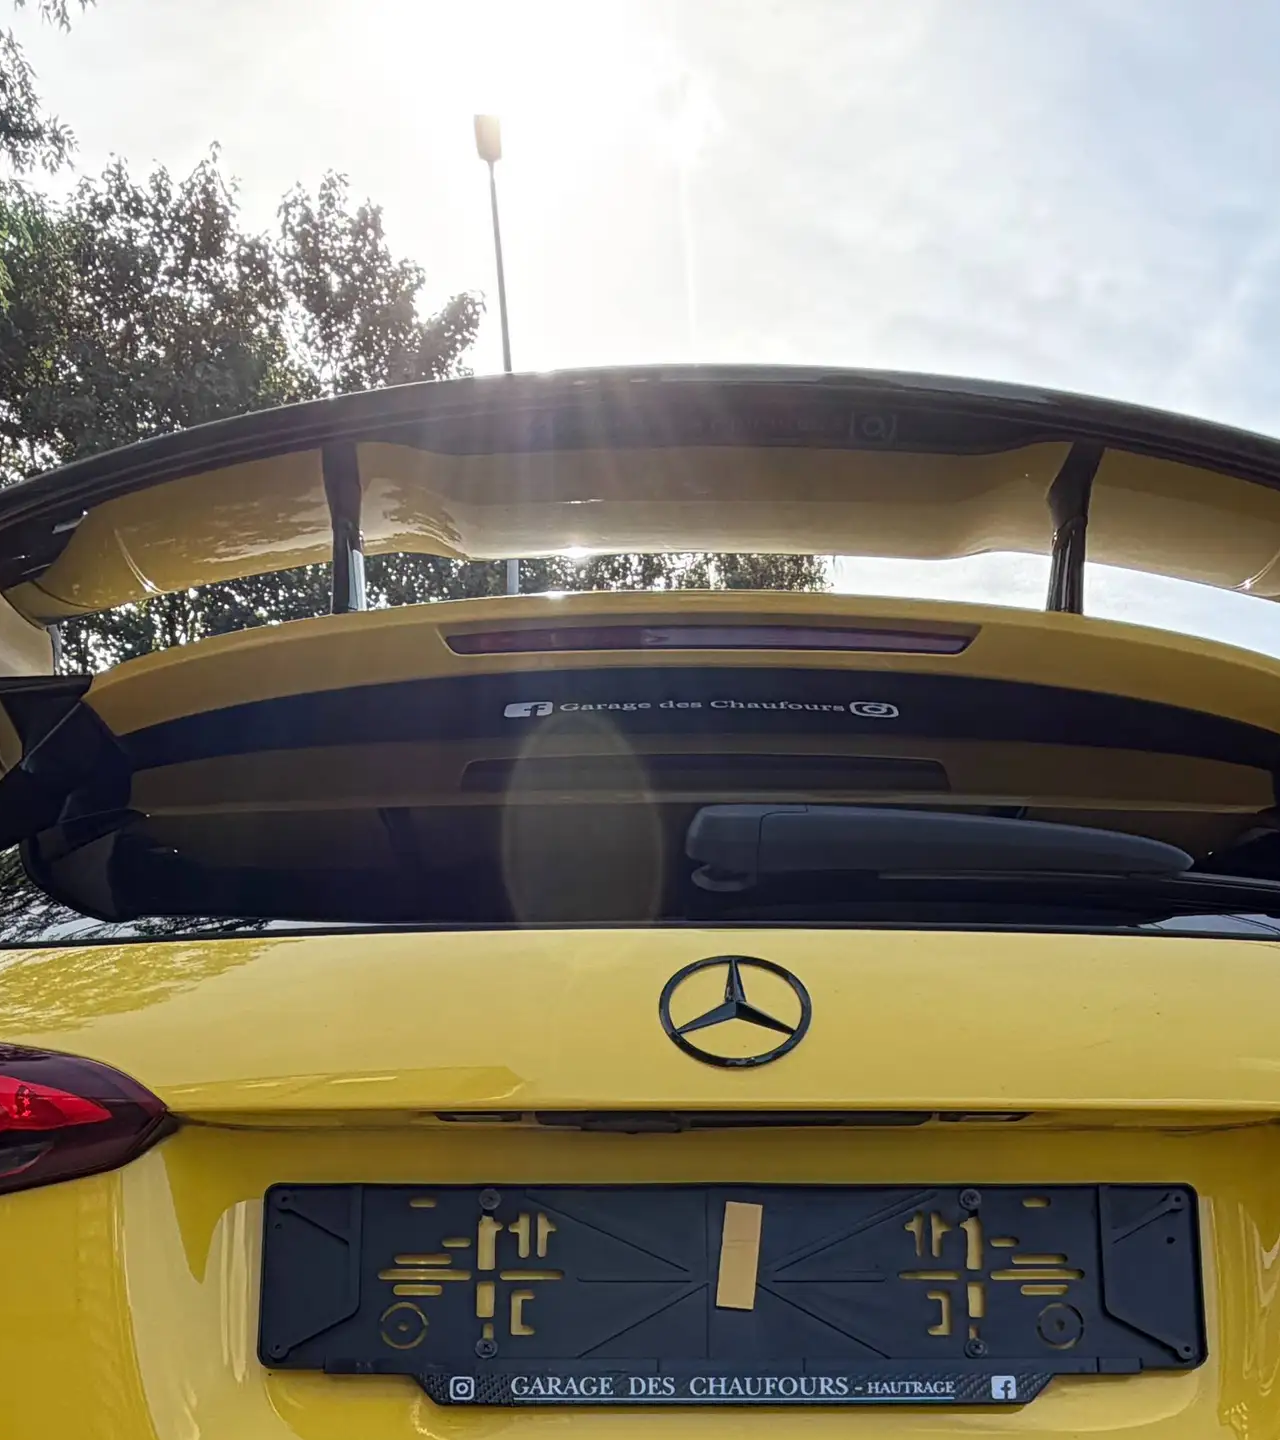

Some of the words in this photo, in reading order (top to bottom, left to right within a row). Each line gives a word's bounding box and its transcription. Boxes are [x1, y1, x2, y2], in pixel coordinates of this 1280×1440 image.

[558, 702, 652, 711] Garage
[659, 700, 703, 709] des
[710, 700, 846, 712] Chaufours
[510, 1376, 614, 1396] GARAGE
[628, 1376, 676, 1396] DES
[688, 1376, 849, 1396] CHAUFOURS
[867, 1381, 956, 1395] HAUTRAGE
